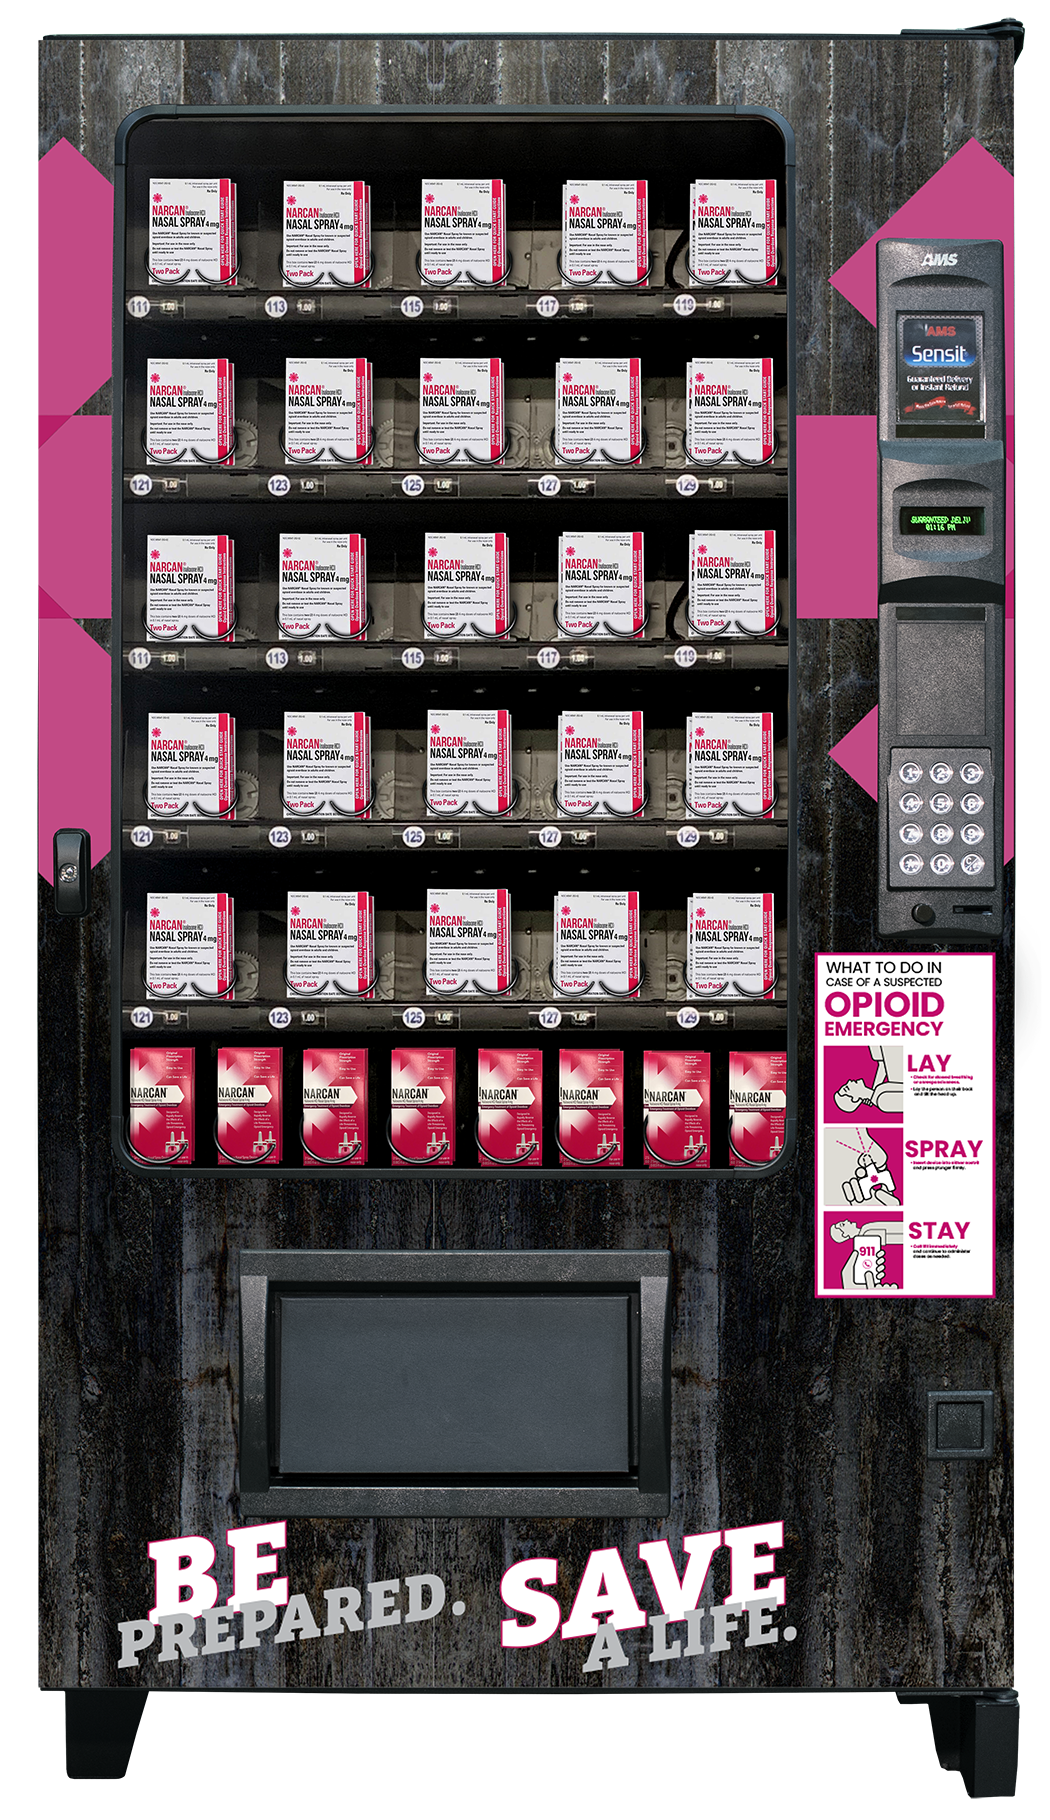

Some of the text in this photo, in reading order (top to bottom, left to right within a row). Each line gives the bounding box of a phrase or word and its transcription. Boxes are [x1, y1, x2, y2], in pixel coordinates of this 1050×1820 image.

[152, 217, 178, 227] NASAL
[180, 217, 206, 227] SPRAY
[286, 219, 340, 229] NASAL SPRAY
[424, 218, 478, 228] NASAL SPRAY
[569, 218, 623, 228] NASAL SPRAY
[698, 218, 752, 228] NASAL SPRAY
[921, 253, 958, 266] AMS
[131, 301, 147, 313] 111
[268, 301, 285, 312] 113
[404, 301, 420, 312] 115
[539, 300, 555, 311] 117
[927, 326, 956, 336] AMS
[946, 376, 973, 384] Delivery
[150, 397, 204, 407] NASAL SPRAY
[288, 396, 342, 406] NASAL SPRAY
[422, 396, 476, 406] NASAL SPRAY
[562, 396, 616, 406] NASAL SPRAY
[694, 396, 748, 406] NASAL SPRAY
[133, 479, 149, 490] 121
[165, 480, 177, 489] 1.00
[271, 480, 287, 491] 123
[301, 481, 314, 490] 1.00
[404, 480, 421, 491] 125
[437, 481, 450, 489] 1.00
[541, 480, 557, 491] 127
[573, 481, 586, 489] 1.00
[679, 480, 696, 491] 129
[712, 480, 723, 489] 1.00
[150, 574, 204, 584] NASAL SPRAY
[282, 572, 336, 582] NASAL SPRAY
[427, 571, 481, 581] NASAL SPRAY
[565, 570, 619, 580] NASAL SPRAY
[697, 569, 751, 579] NASAL SPRAY
[131, 652, 148, 664] 111
[269, 652, 286, 664] 113
[404, 652, 421, 663] 115
[540, 652, 556, 663] 117
[151, 751, 205, 761] NASAL SPRAY
[287, 750, 341, 760] NASAL SPRAY
[430, 748, 484, 758] NASAL SPRAY
[564, 749, 618, 759] NASAL SPRAY
[694, 751, 748, 761] NASAL SPRAY
[134, 831, 150, 842] 121
[271, 831, 288, 842] 123
[405, 831, 422, 842] 125
[542, 831, 558, 842] 127
[680, 831, 697, 842] 129
[149, 931, 203, 941] NASAL SPRAY
[290, 930, 344, 940] NASAL SPRAY
[429, 927, 483, 937] NASAL SPRAY
[560, 930, 614, 940] NASAL SPRAY
[695, 931, 749, 941] NASAL SPRAY
[826, 962, 942, 973] WHAT TO DO IN
[826, 978, 942, 987] CASE OF A SUSPECTED
[825, 991, 945, 1017] OPIOID
[134, 1012, 150, 1023] 121
[271, 1012, 288, 1023] 123
[405, 1012, 422, 1023] 125
[542, 1012, 558, 1023] 127
[680, 1012, 697, 1023] 129
[825, 1021, 944, 1036] EMERGENCY
[908, 1054, 952, 1072] LAY
[905, 1140, 983, 1158] SPRAY
[909, 1222, 970, 1239] STAY
[859, 1247, 875, 1256] 911
[148, 1521, 288, 1625] BE
[500, 1521, 786, 1648] SAVE
[118, 1573, 466, 1669] PREPARED.
[582, 1596, 798, 1673] A LIFE.
